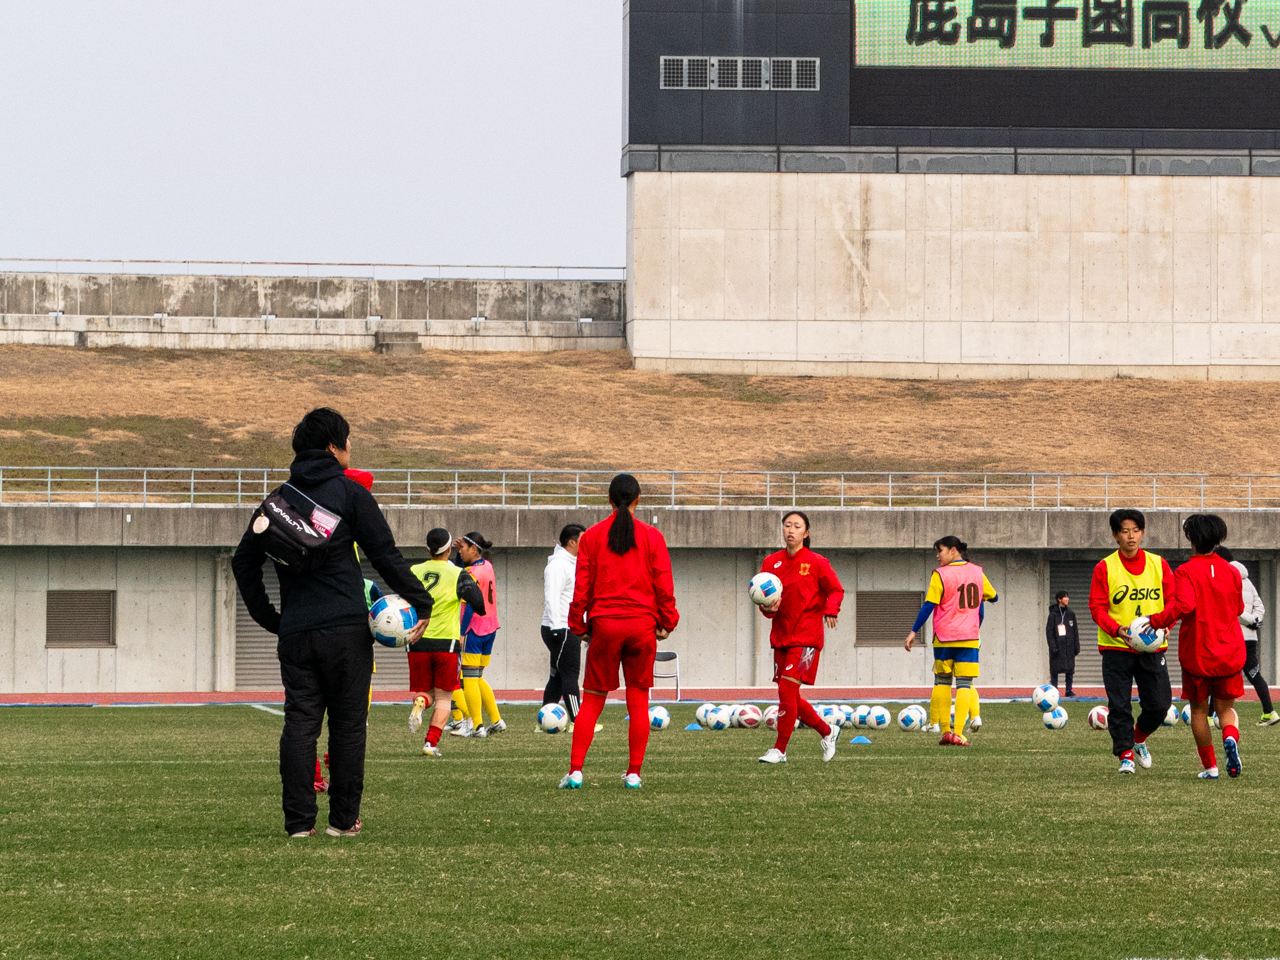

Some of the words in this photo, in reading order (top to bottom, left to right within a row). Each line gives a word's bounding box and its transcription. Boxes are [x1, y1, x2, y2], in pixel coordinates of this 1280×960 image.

[957, 583, 980, 609] 10
[1129, 588, 1160, 601] asics
[1135, 605, 1142, 617] 4
